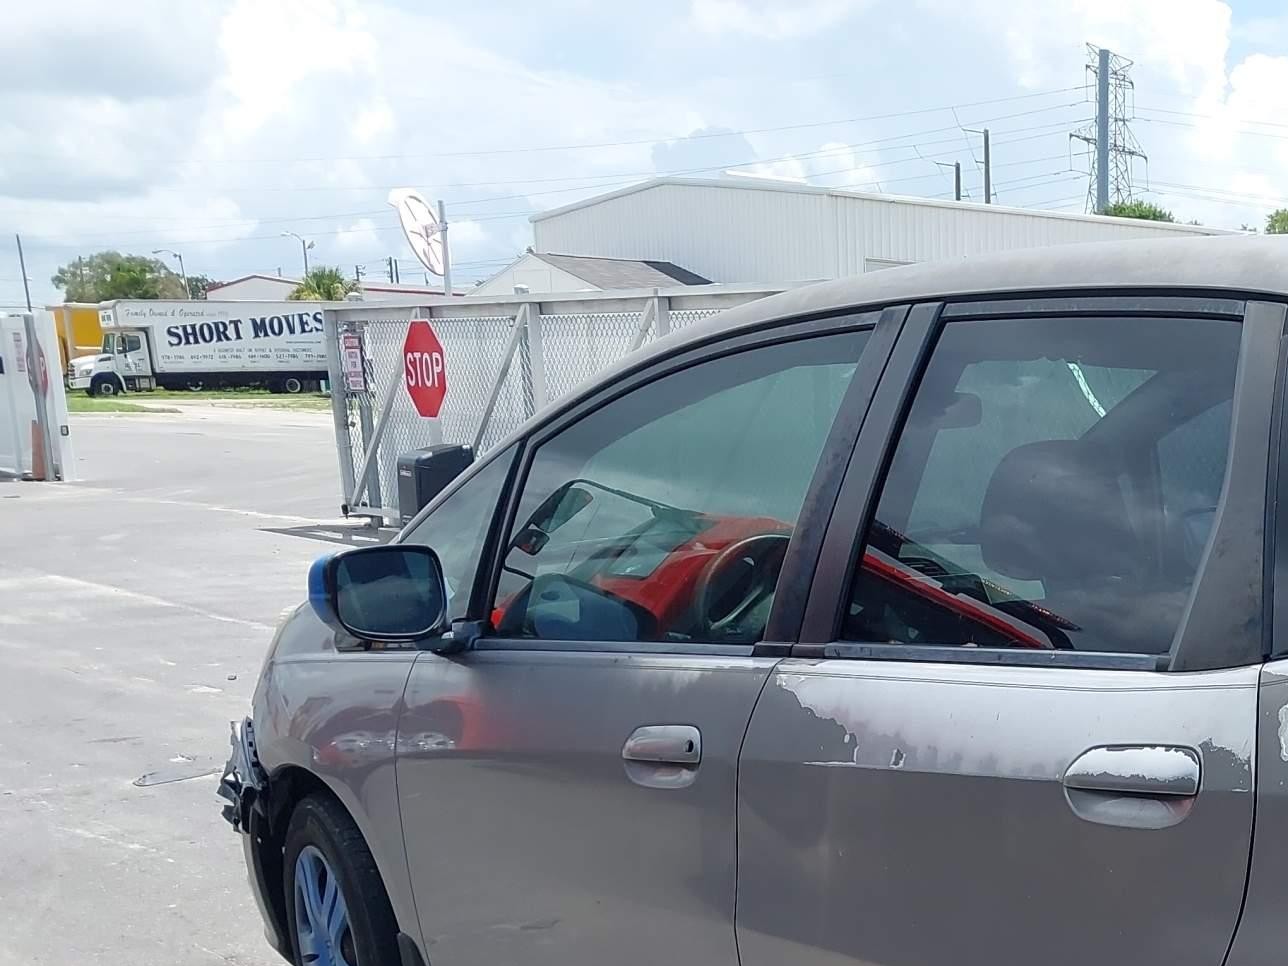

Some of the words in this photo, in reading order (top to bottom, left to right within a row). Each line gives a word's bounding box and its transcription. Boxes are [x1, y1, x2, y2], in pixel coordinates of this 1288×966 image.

[166, 318, 243, 347] SHORT
[249, 311, 324, 340] MOVES
[406, 352, 443, 388] STOP
